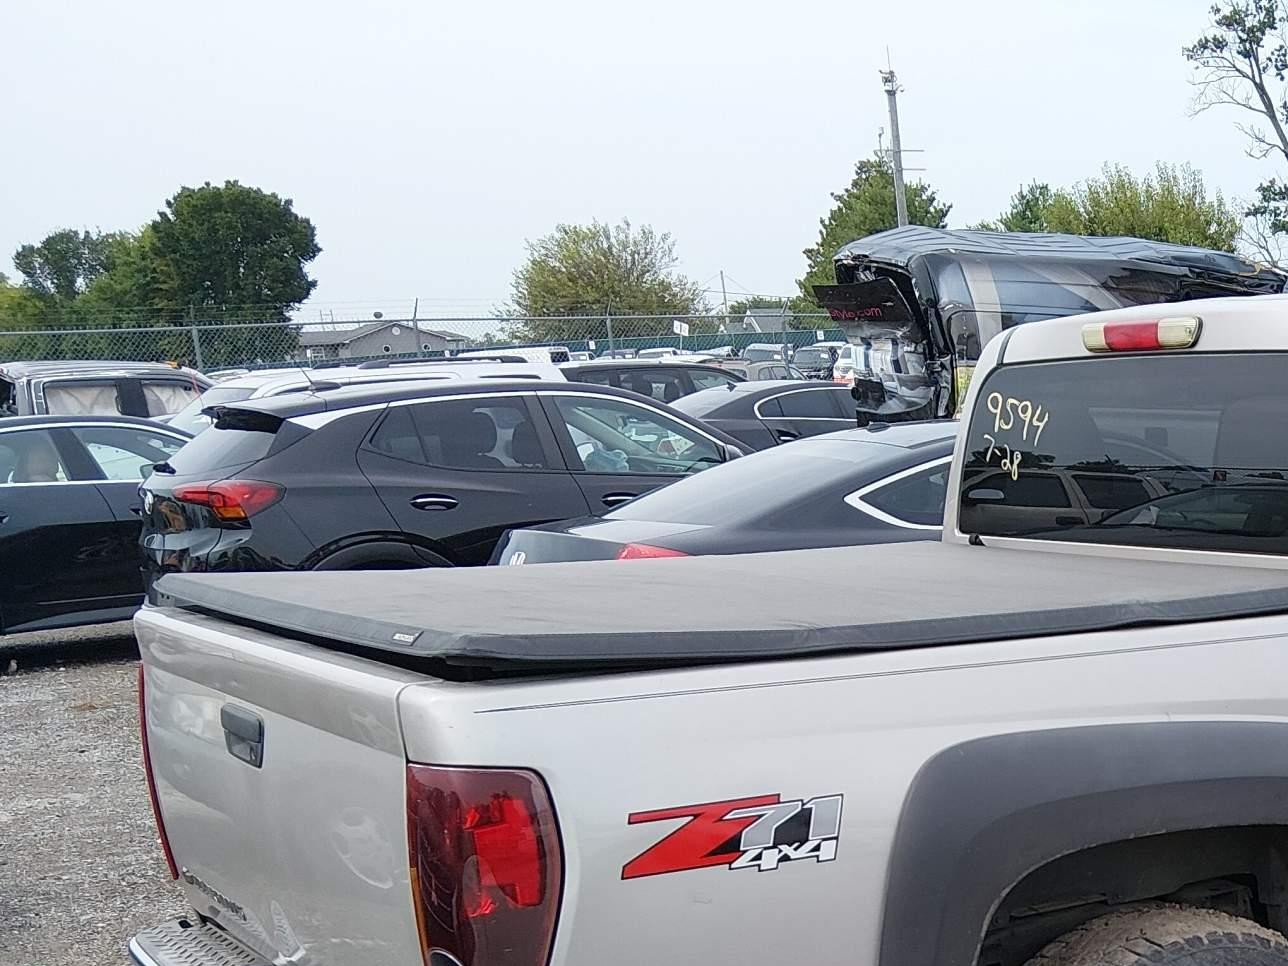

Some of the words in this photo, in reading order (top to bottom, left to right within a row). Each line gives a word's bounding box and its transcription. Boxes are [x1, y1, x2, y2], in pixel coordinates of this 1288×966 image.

[987, 392, 1049, 447] 9594
[983, 433, 1022, 481] 7-28
[621, 793, 844, 880] Z71
[728, 839, 838, 872] 4x4
